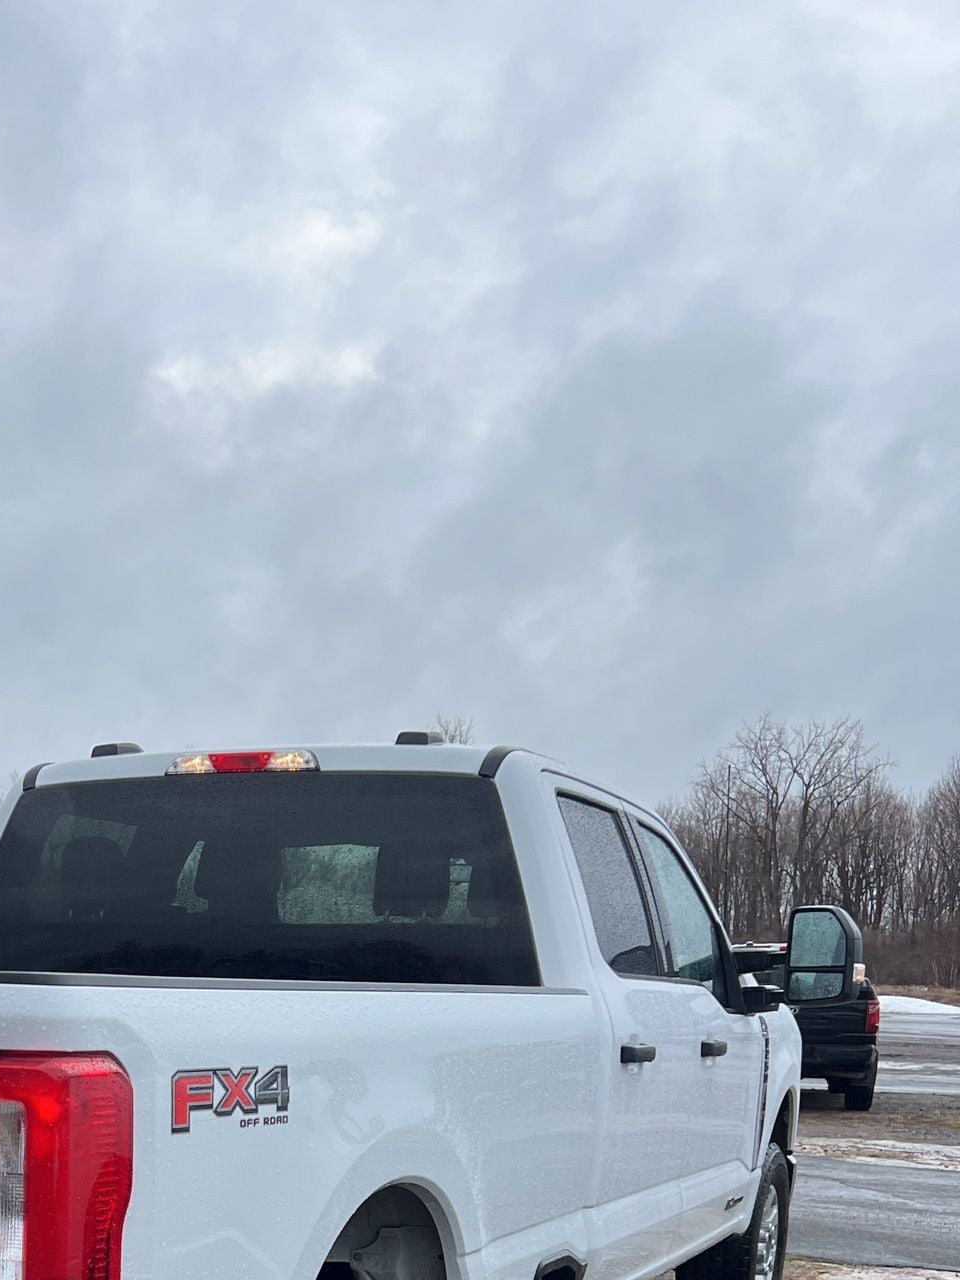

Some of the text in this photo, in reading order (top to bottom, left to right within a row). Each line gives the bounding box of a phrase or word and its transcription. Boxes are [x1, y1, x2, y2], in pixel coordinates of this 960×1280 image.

[171, 1065, 289, 1133] FX4
[239, 1115, 289, 1128] OFF ROAD
